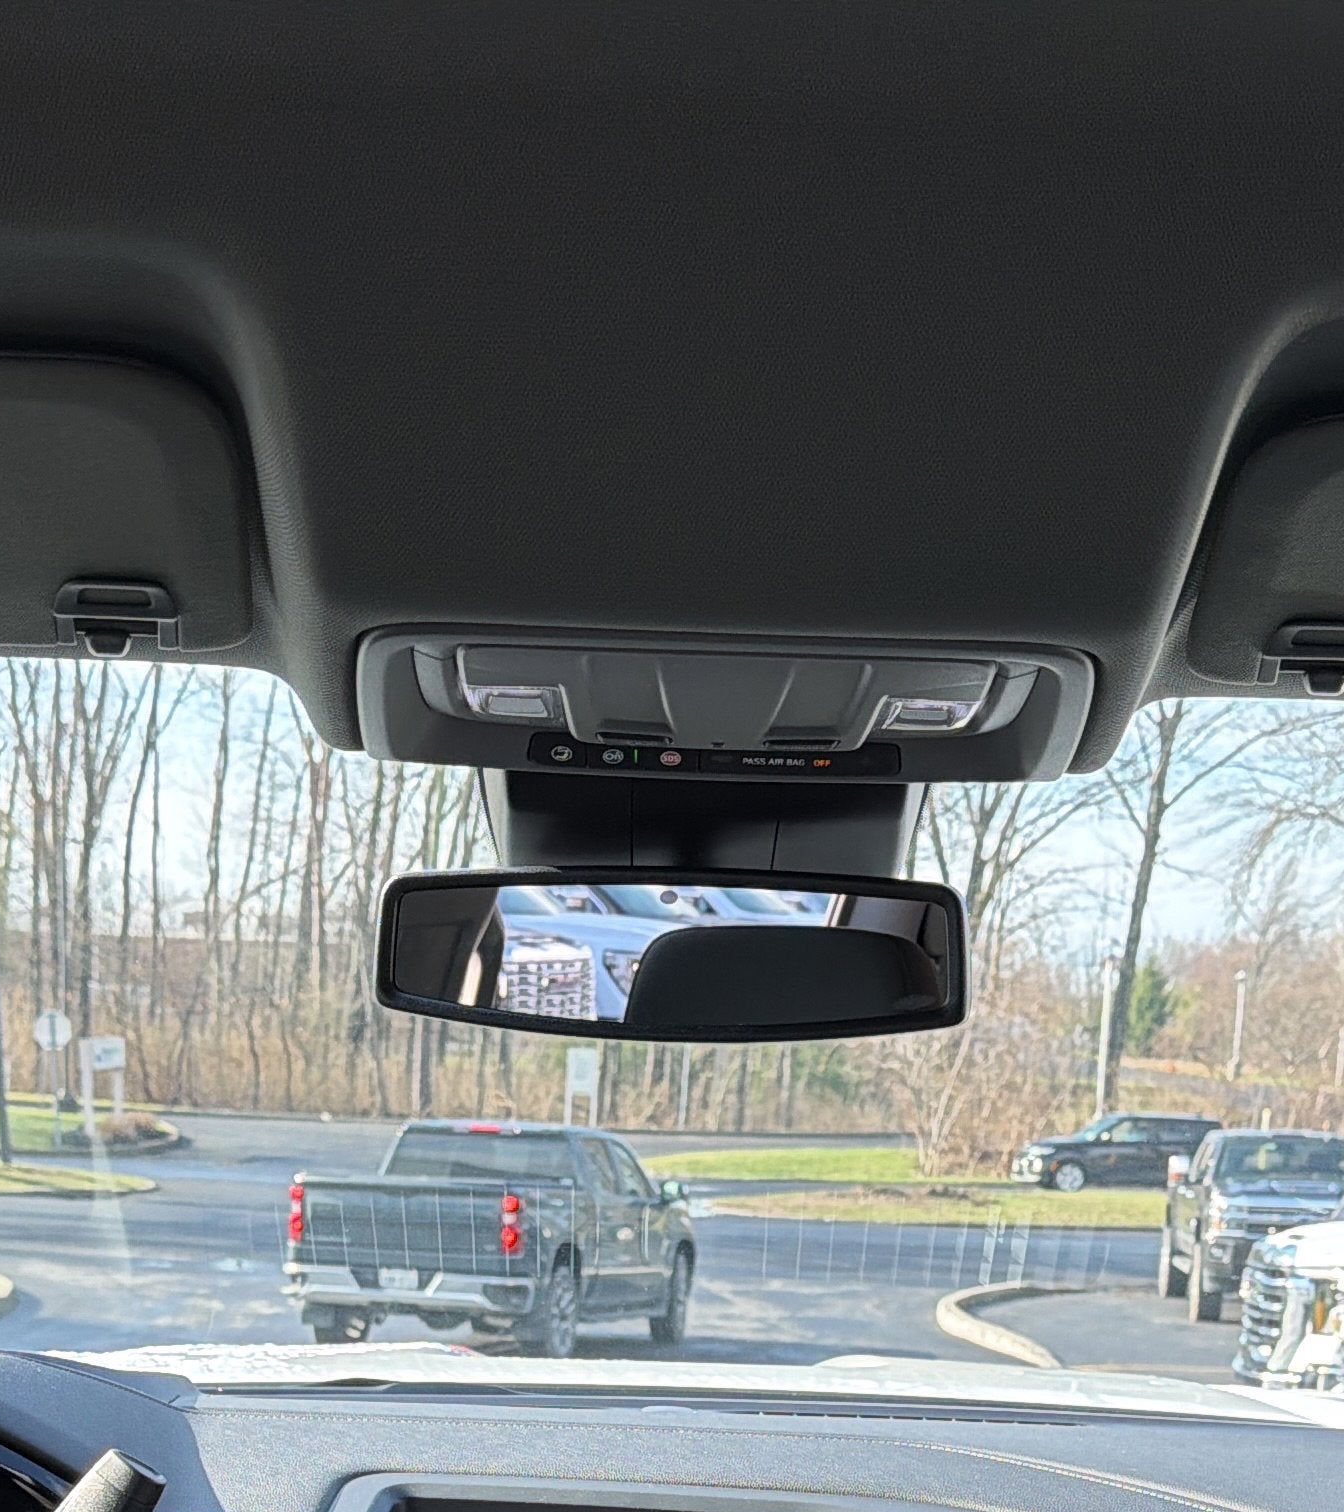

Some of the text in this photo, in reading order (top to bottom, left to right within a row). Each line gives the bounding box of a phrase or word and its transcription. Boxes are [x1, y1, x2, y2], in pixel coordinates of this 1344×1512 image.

[742, 758, 832, 768] PASS AIR BAG OFF
